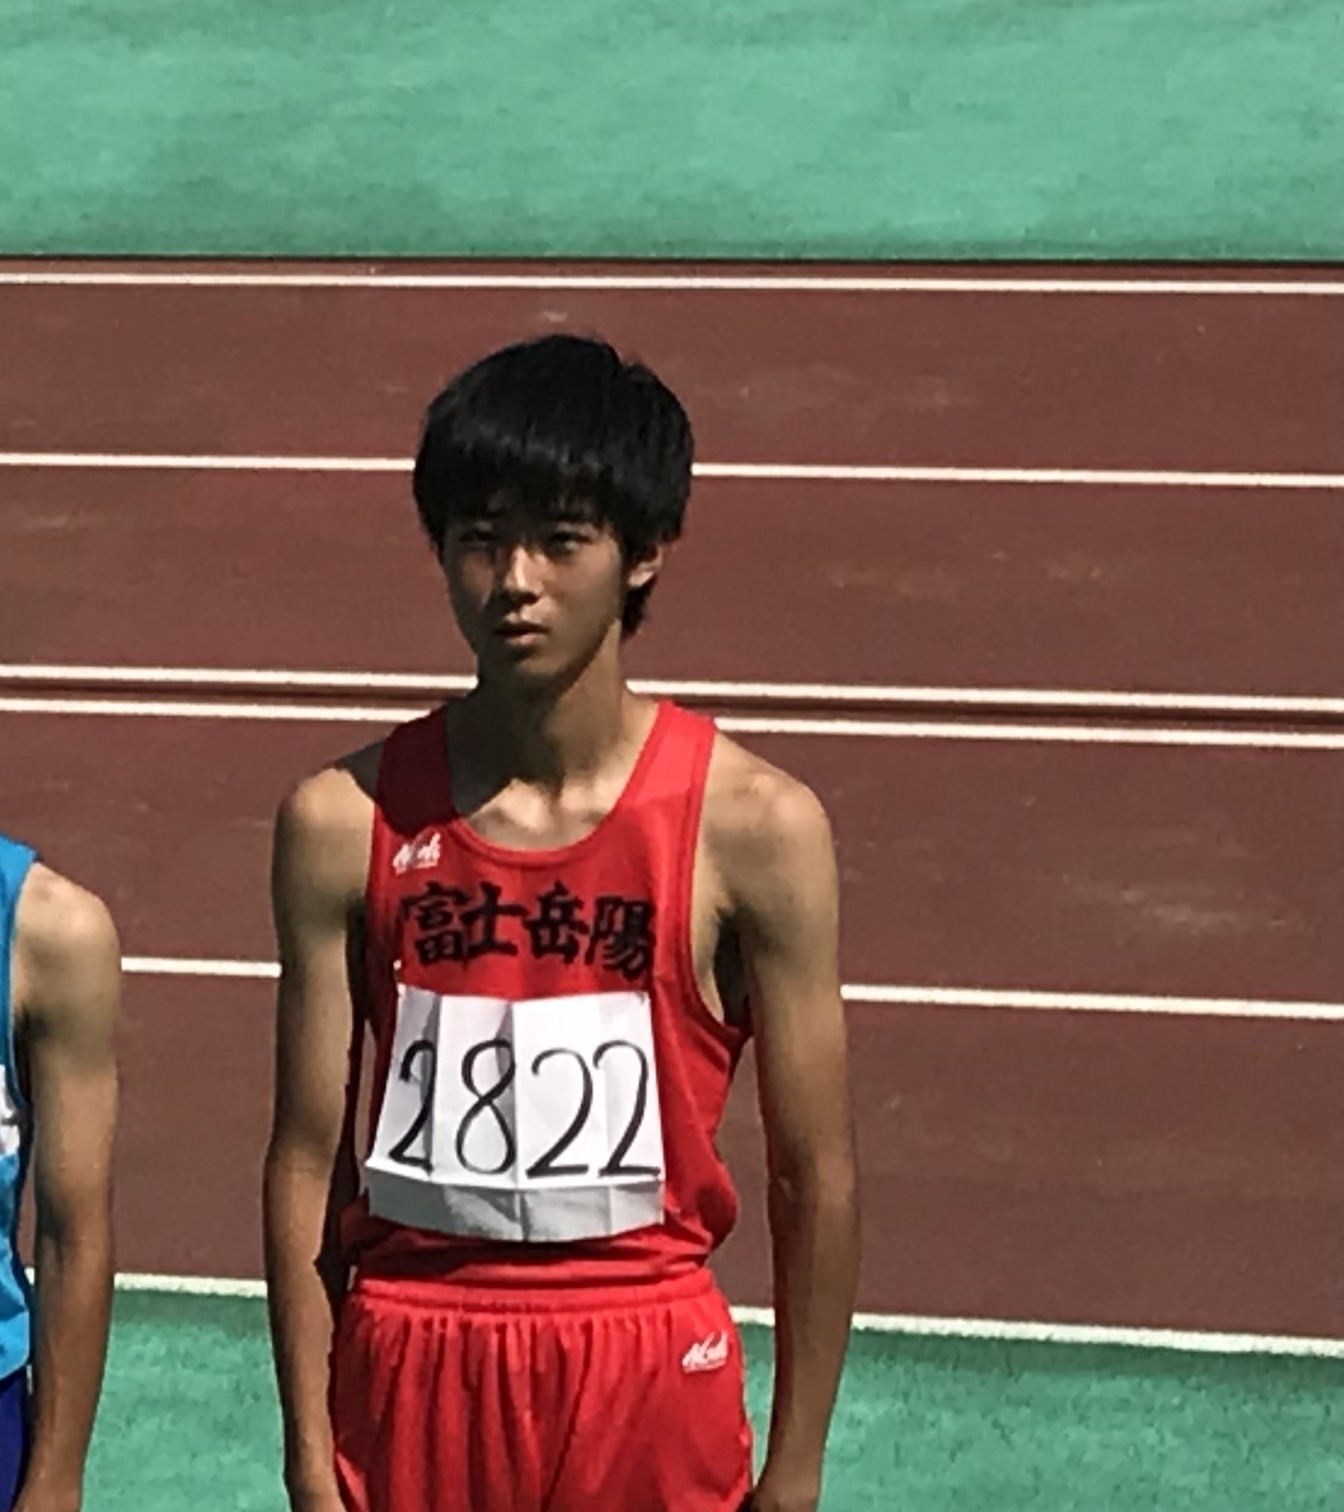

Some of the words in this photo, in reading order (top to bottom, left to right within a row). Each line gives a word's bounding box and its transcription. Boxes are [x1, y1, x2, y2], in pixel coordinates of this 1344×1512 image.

[402, 881, 656, 981] 富士岳陽
[388, 1039, 662, 1178] 2822
